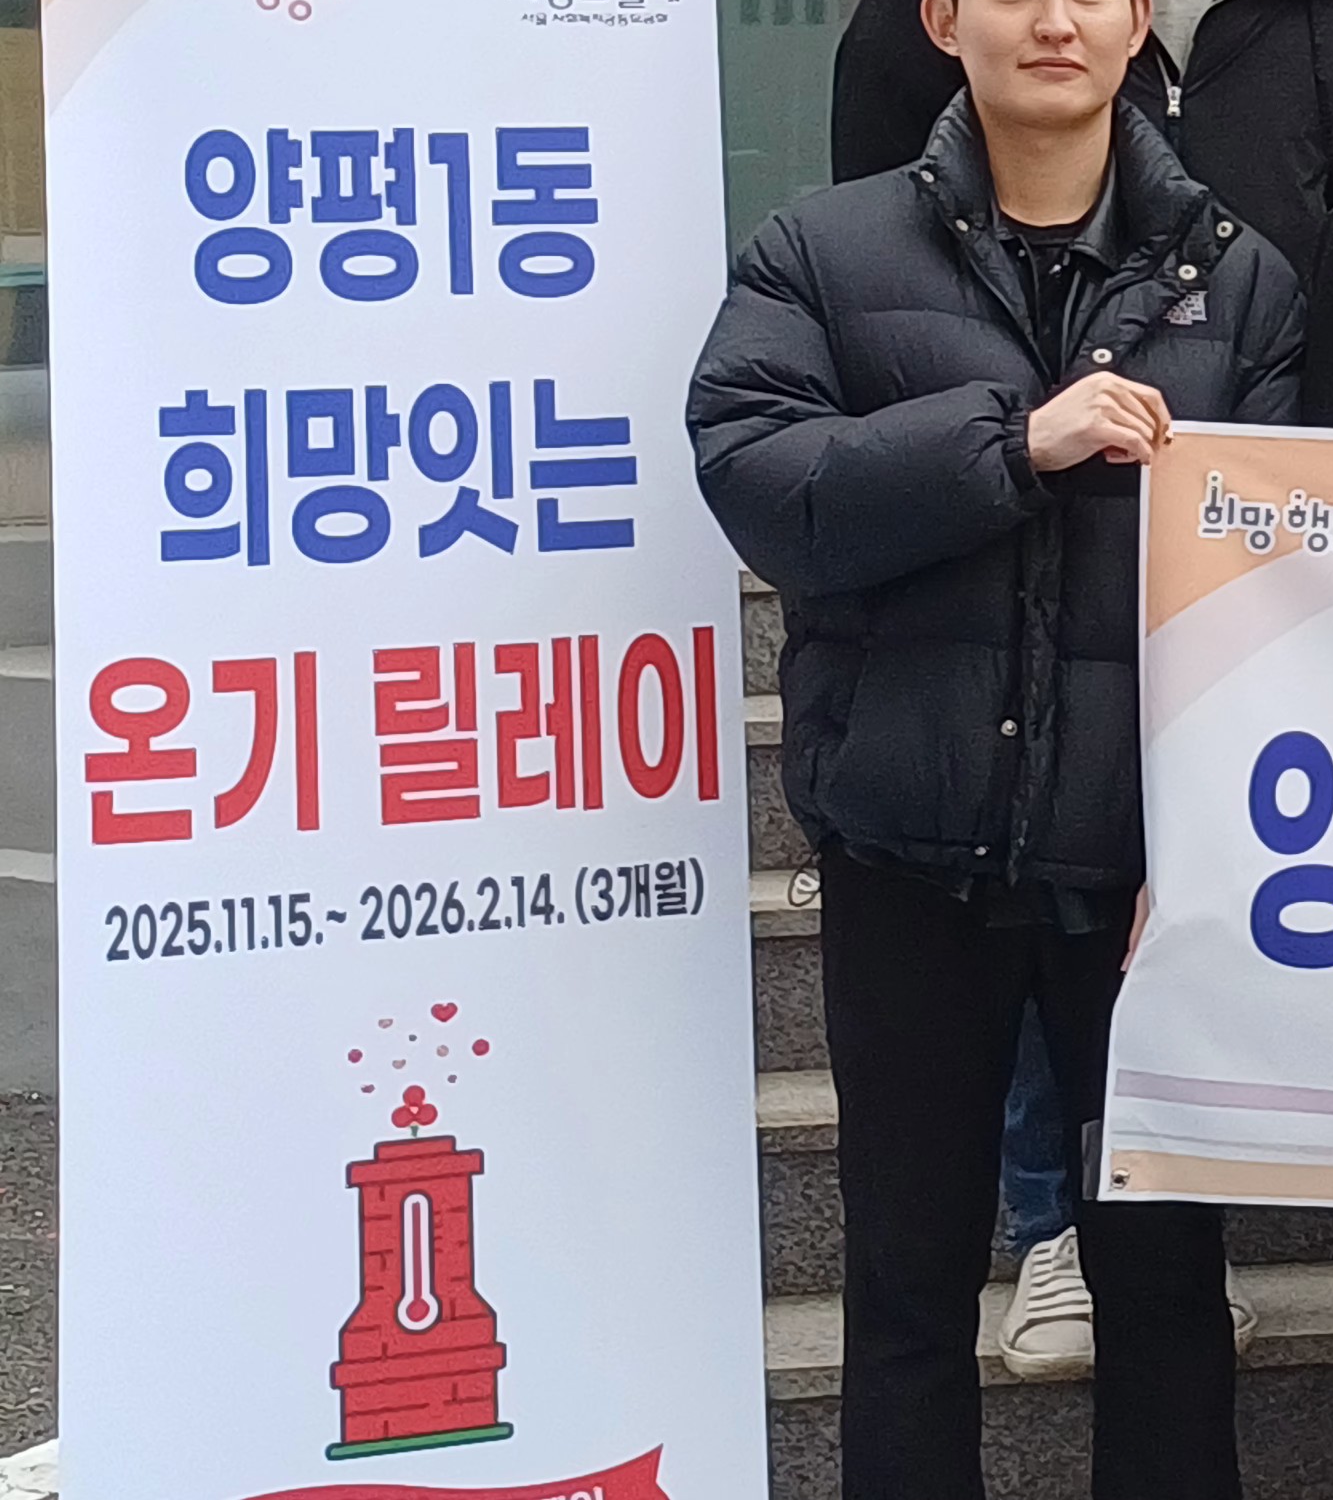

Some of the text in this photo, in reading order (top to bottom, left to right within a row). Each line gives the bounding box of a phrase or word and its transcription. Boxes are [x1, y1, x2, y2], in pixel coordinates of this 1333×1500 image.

[185, 126, 599, 305] 양평1동
[158, 378, 637, 567] 희망잇는
[1202, 475, 1275, 550] 희망
[85, 624, 719, 845] 온기 릴레이
[360, 872, 565, 941] 2026.2.14.
[575, 857, 705, 925] (3개월)
